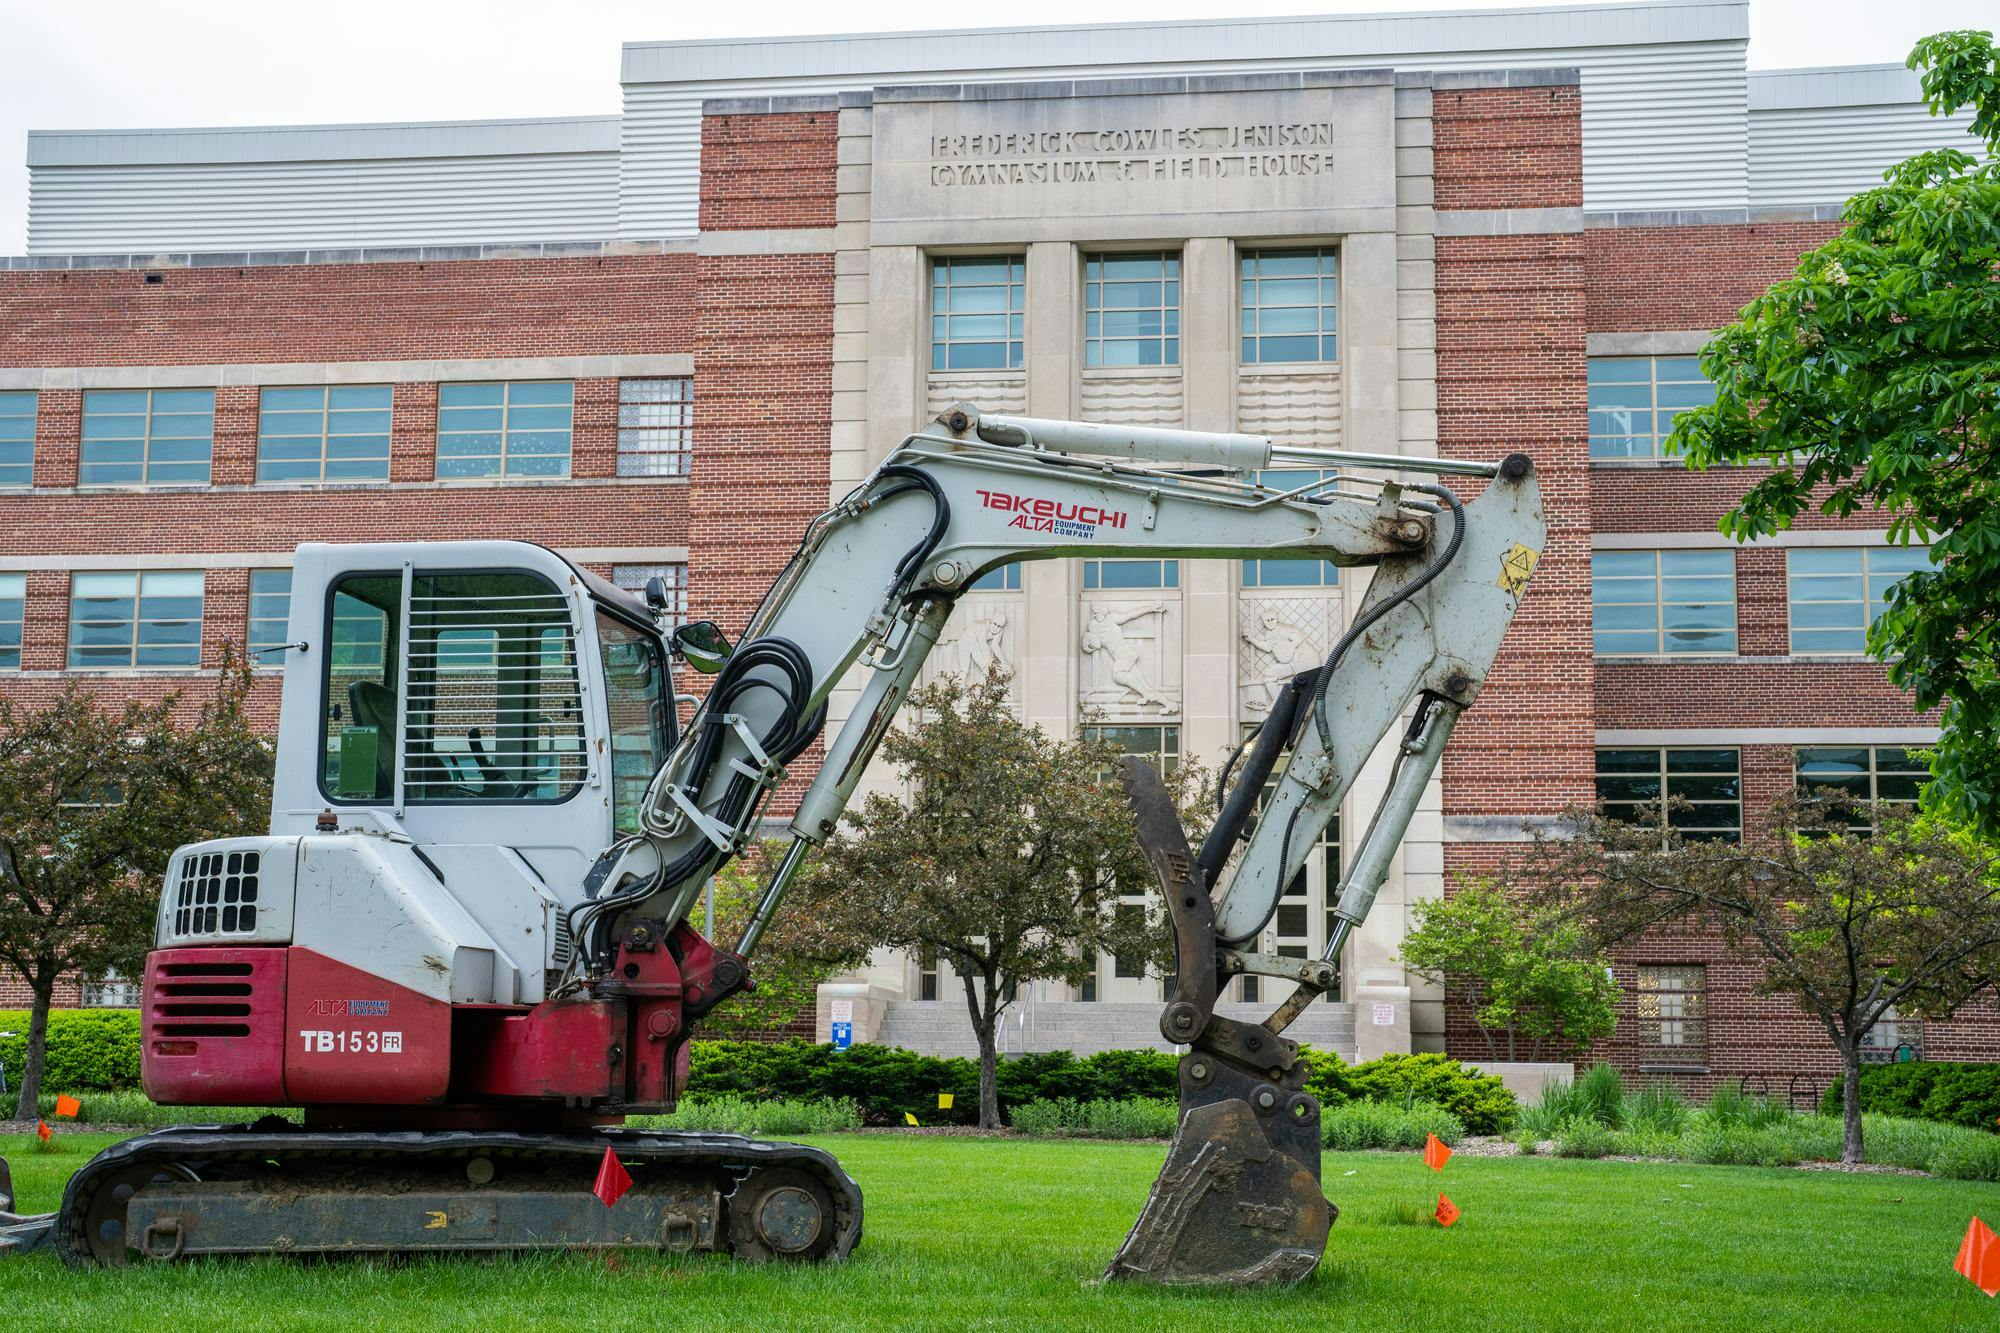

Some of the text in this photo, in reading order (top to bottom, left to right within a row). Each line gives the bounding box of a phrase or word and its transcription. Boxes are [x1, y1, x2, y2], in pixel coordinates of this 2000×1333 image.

[931, 123, 1333, 157] FREDERICK COWLES JENISON
[931, 161, 1102, 187] GYMNASIUM
[1148, 157, 1228, 180] FIELD
[1243, 154, 1334, 178] HOUSE
[1008, 514, 1054, 533] ALTA
[1055, 520, 1096, 532] EQUIPMENT
[1053, 528, 1095, 539] COMPANY
[305, 1000, 348, 1016] ALTA
[349, 1000, 390, 1009] EQUIPMENT
[349, 1008, 390, 1016] COMPANY
[300, 1030, 401, 1053] TB153 FR
